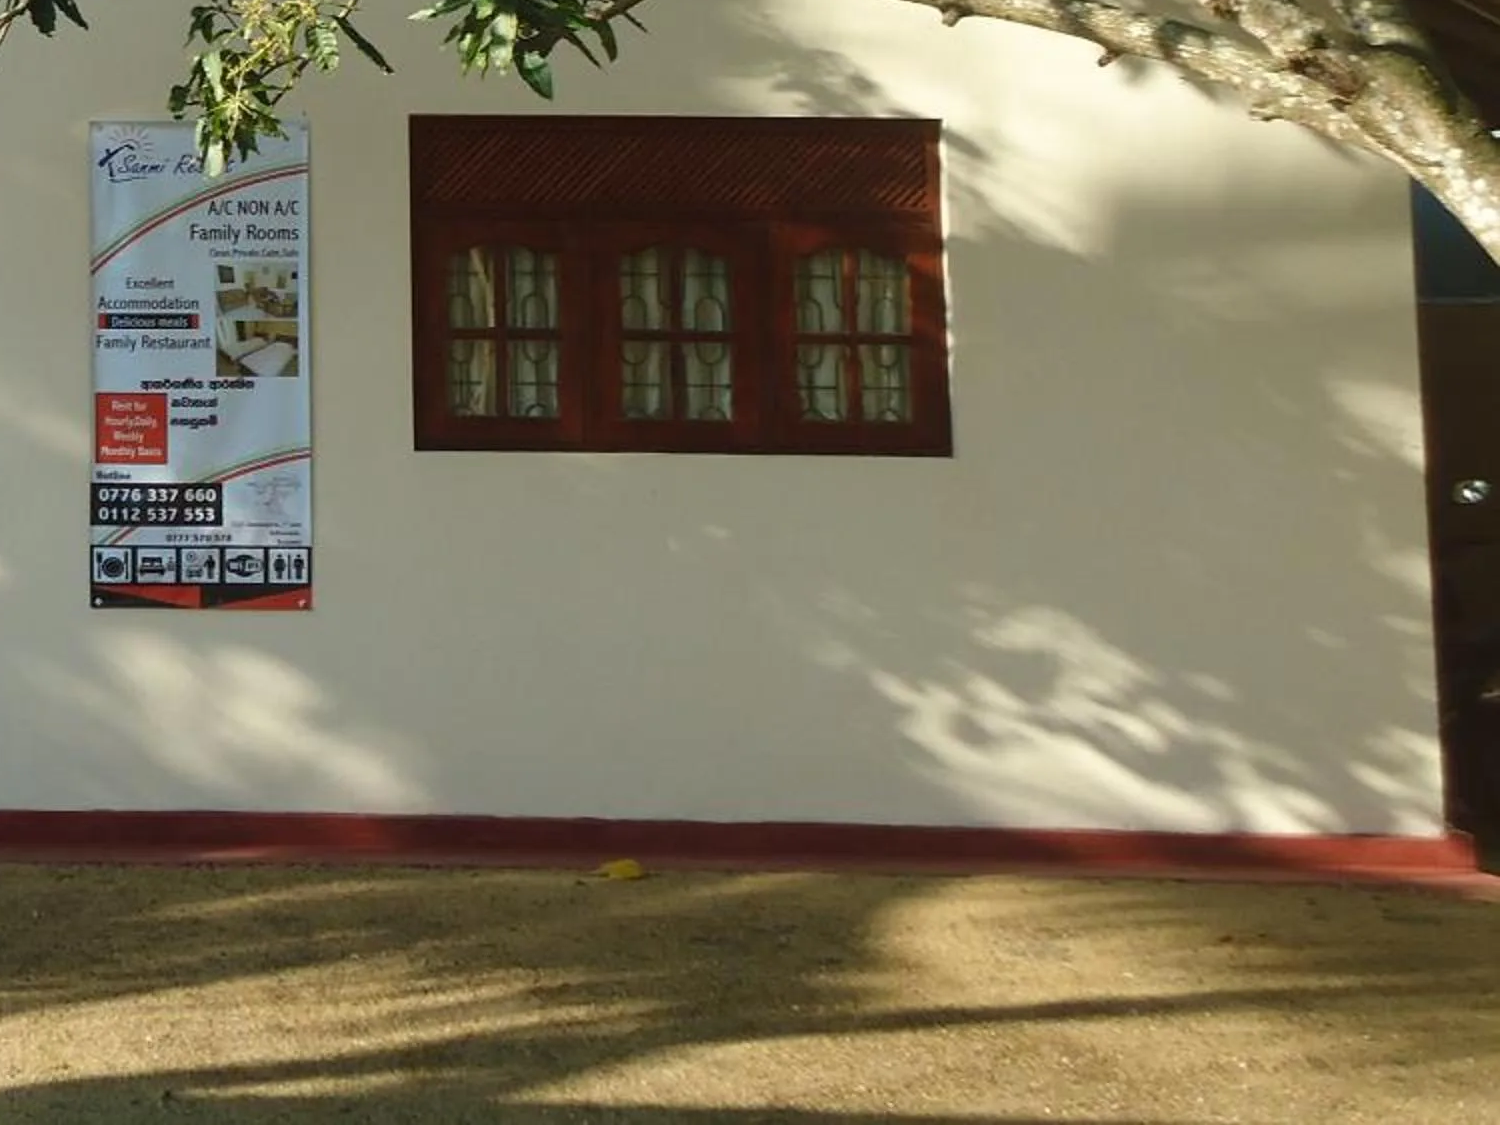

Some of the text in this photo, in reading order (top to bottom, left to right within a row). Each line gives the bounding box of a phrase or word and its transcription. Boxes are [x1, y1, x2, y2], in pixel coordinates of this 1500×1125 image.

[208, 200, 299, 216] A/C NON A/C
[190, 224, 299, 245] Family Rooms
[126, 277, 174, 289] Excellent
[98, 296, 199, 310] Accommodation
[111, 316, 156, 327] Delicious
[96, 335, 211, 352] Family Restaurant
[99, 488, 217, 502] 0776 337 660
[99, 507, 215, 522] 0112 537 553
